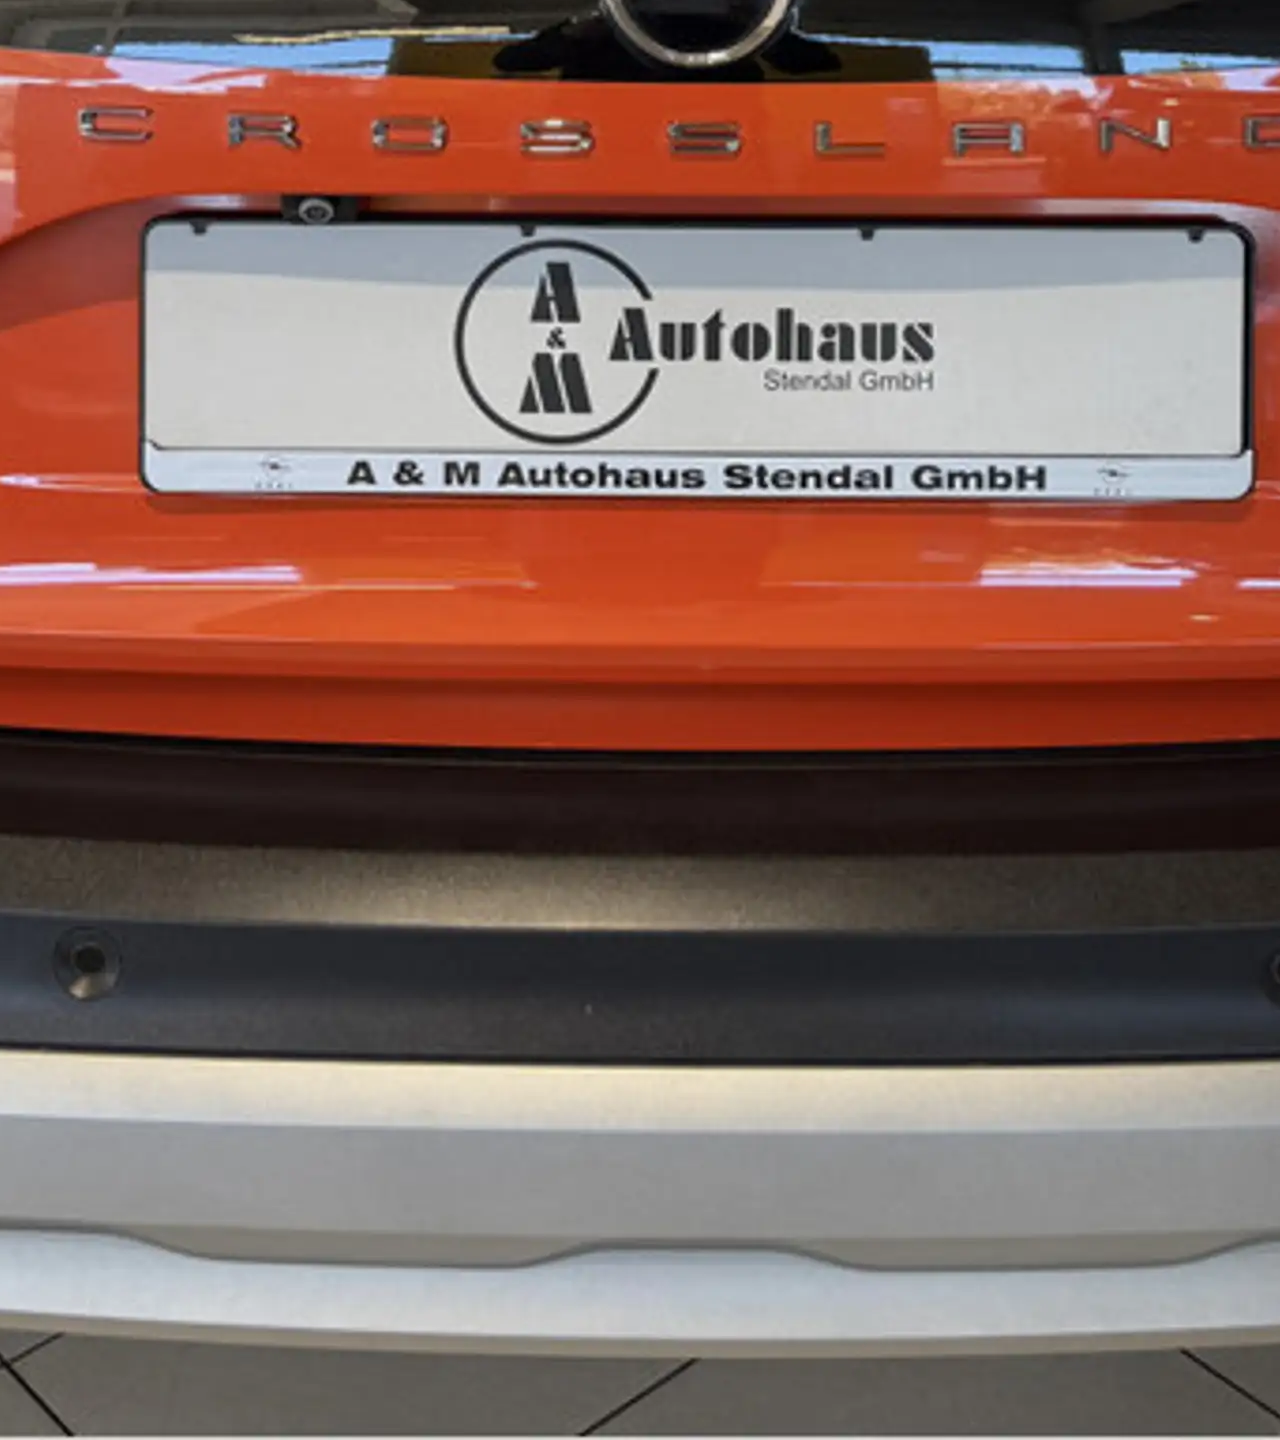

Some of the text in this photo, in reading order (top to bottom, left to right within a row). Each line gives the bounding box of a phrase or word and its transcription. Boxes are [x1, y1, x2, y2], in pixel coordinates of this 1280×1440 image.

[530, 261, 582, 323] A
[546, 327, 567, 349] &
[609, 307, 936, 363] Autohaus
[519, 352, 593, 414] M
[763, 368, 934, 392] Stendal GmbH
[346, 460, 1047, 491] A & M Autohaus Stendal GmbH
